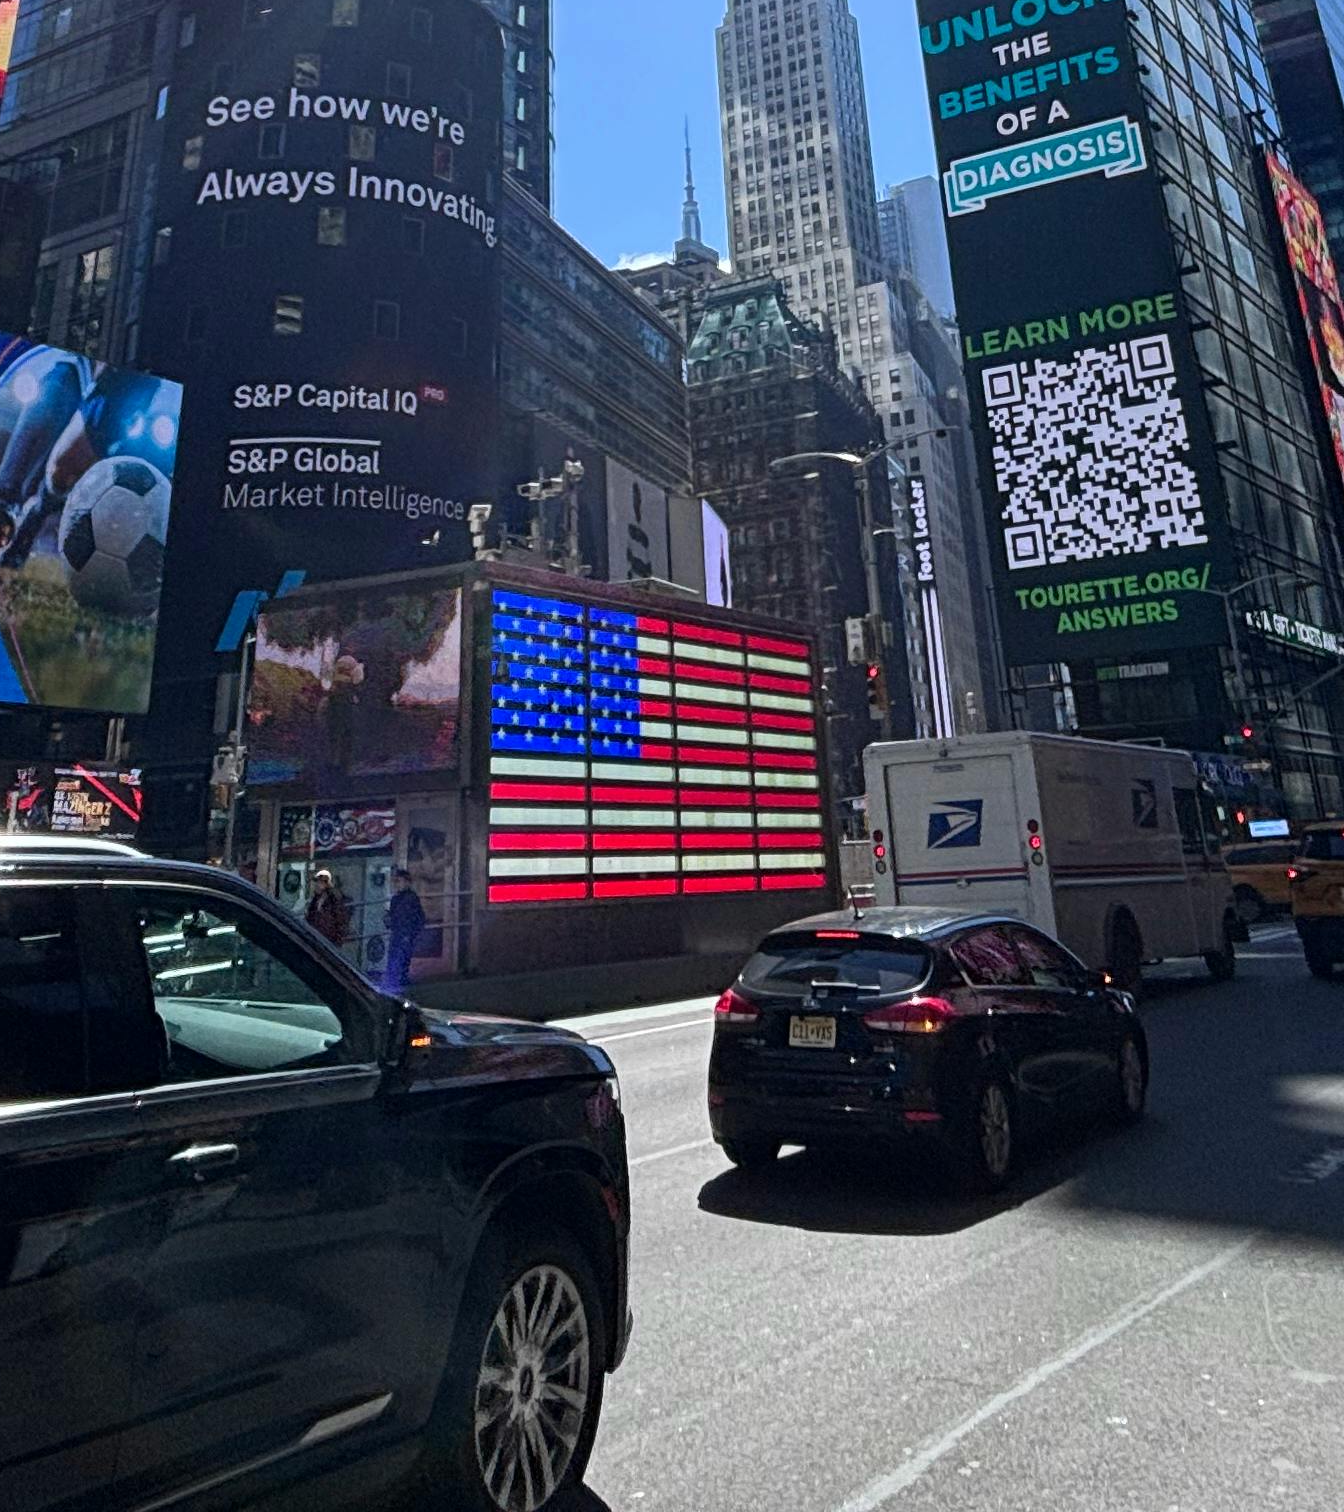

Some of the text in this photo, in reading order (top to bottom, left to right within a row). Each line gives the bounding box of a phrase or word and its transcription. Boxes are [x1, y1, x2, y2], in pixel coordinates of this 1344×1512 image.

[992, 32, 1052, 66] THE
[939, 45, 1121, 120] BENEFITS
[206, 87, 466, 145] See how we’re
[996, 99, 1070, 136] OF A
[958, 129, 1127, 194] DIAGNOSIS
[196, 167, 336, 205] Always
[965, 293, 1178, 360] LEARN MORE
[233, 385, 292, 409] S&P
[297, 384, 389, 413] Capital
[394, 389, 418, 415] IQ
[227, 447, 381, 475] S&P Global
[222, 481, 464, 521] Market Intelligence
[1016, 562, 1212, 611] TOURETTE.ORG/
[1057, 598, 1179, 634] ANSWERS
